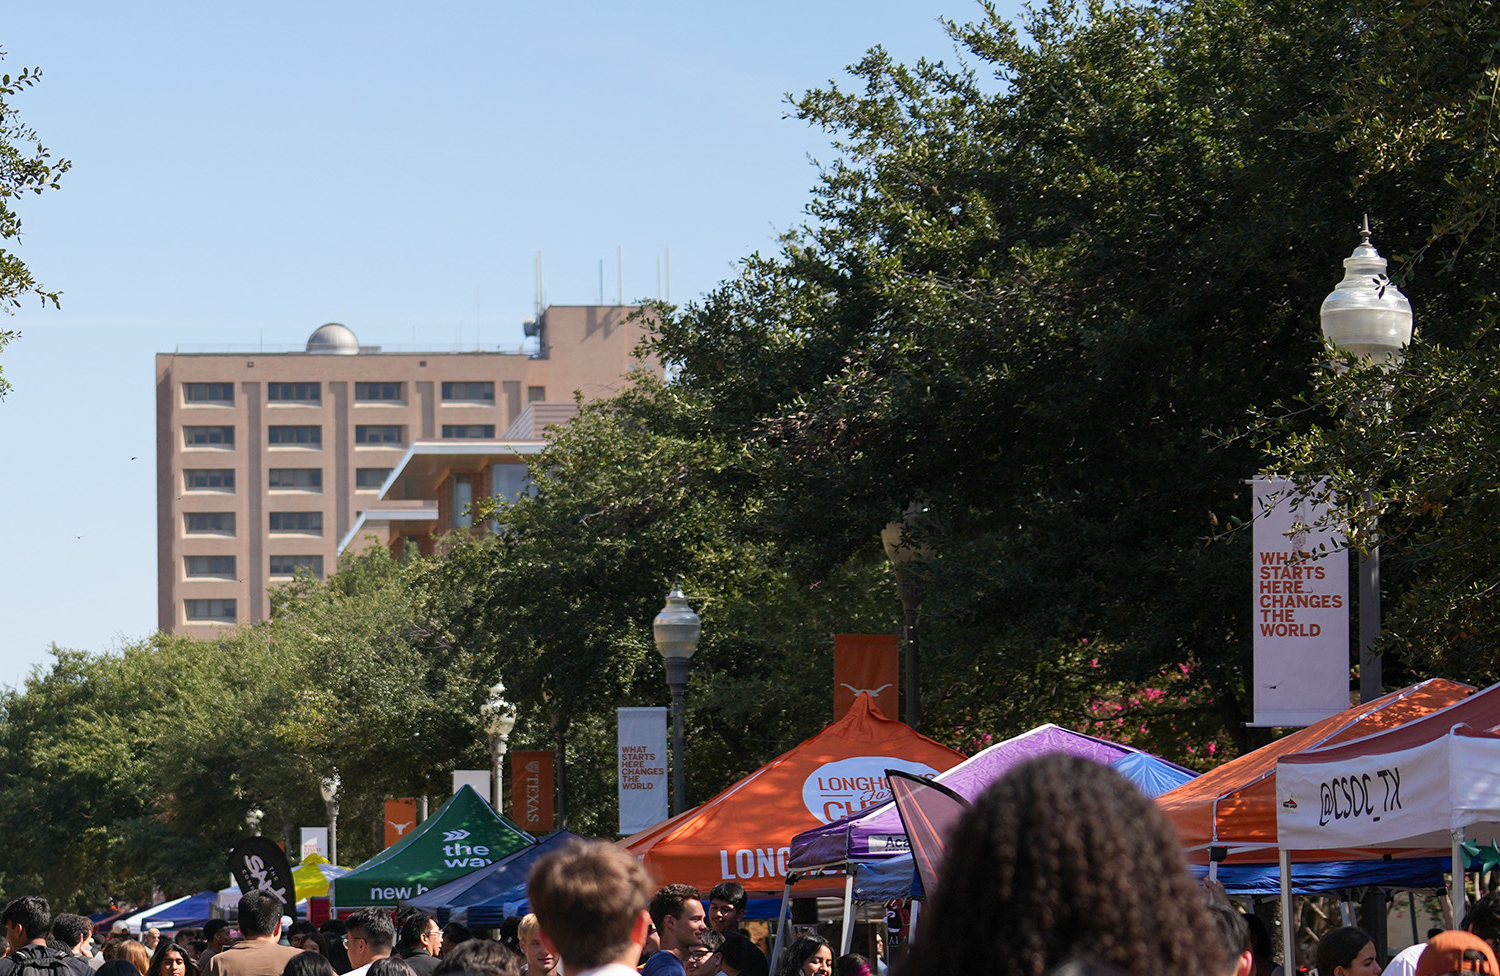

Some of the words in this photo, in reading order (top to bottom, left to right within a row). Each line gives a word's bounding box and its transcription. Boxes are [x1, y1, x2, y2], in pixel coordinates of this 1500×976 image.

[1260, 566, 1326, 580] STARTS
[1260, 581, 1304, 594] HERE
[1260, 595, 1343, 608] CHANGES
[1260, 609, 1295, 622] THE
[1260, 623, 1321, 637] WORLD
[526, 774, 540, 822] TEXAS
[885, 836, 910, 847] Aca
[443, 843, 490, 856] the
[269, 866, 279, 881] THE
[371, 887, 412, 900] new
[417, 883, 429, 895] h
